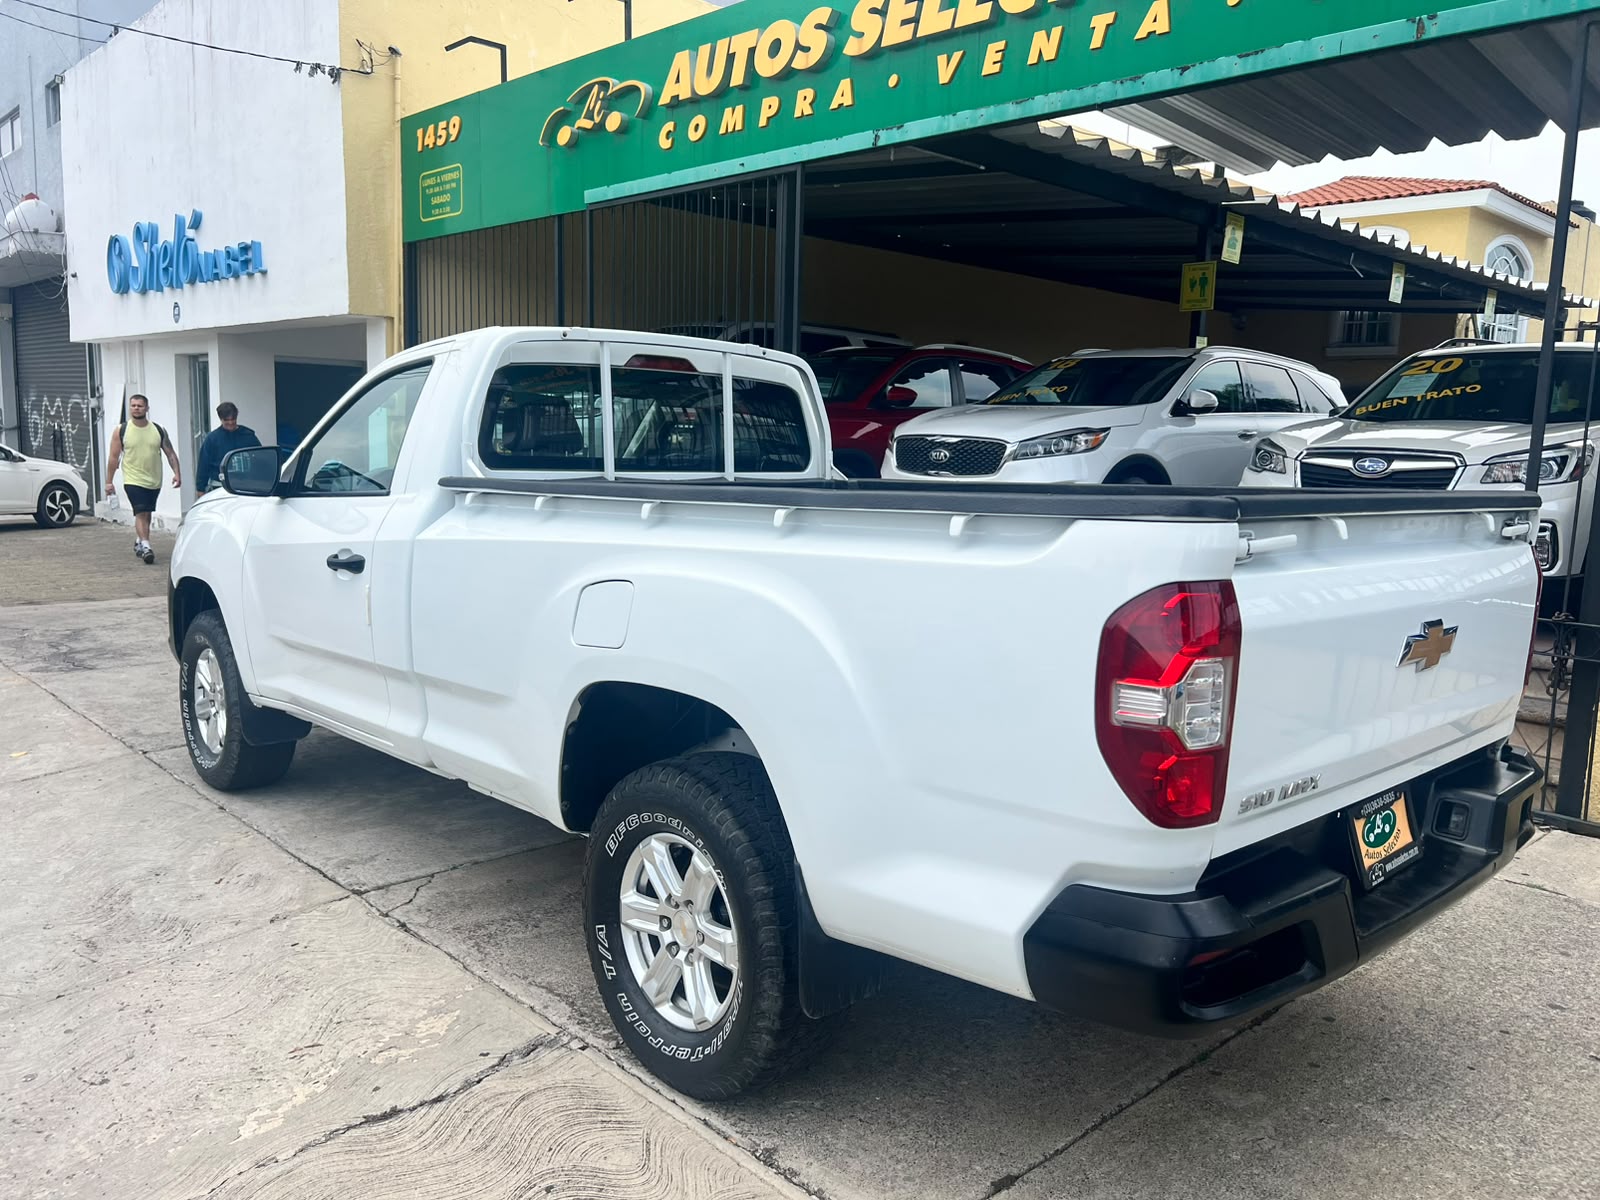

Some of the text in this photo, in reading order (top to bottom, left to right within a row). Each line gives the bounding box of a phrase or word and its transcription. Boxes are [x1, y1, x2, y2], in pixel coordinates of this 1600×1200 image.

[658, 6, 840, 106] AUTOS
[658, 0, 1172, 151] COMPRA VENTA
[416, 115, 462, 153] 1459
[197, 240, 268, 283] NABEL
[1355, 397, 1408, 415] BUEN
[1415, 384, 1482, 401] TRATO
[1364, 848, 1383, 860] Autos
[1382, 828, 1402, 857] Selectos
[595, 924, 617, 980] T/A
